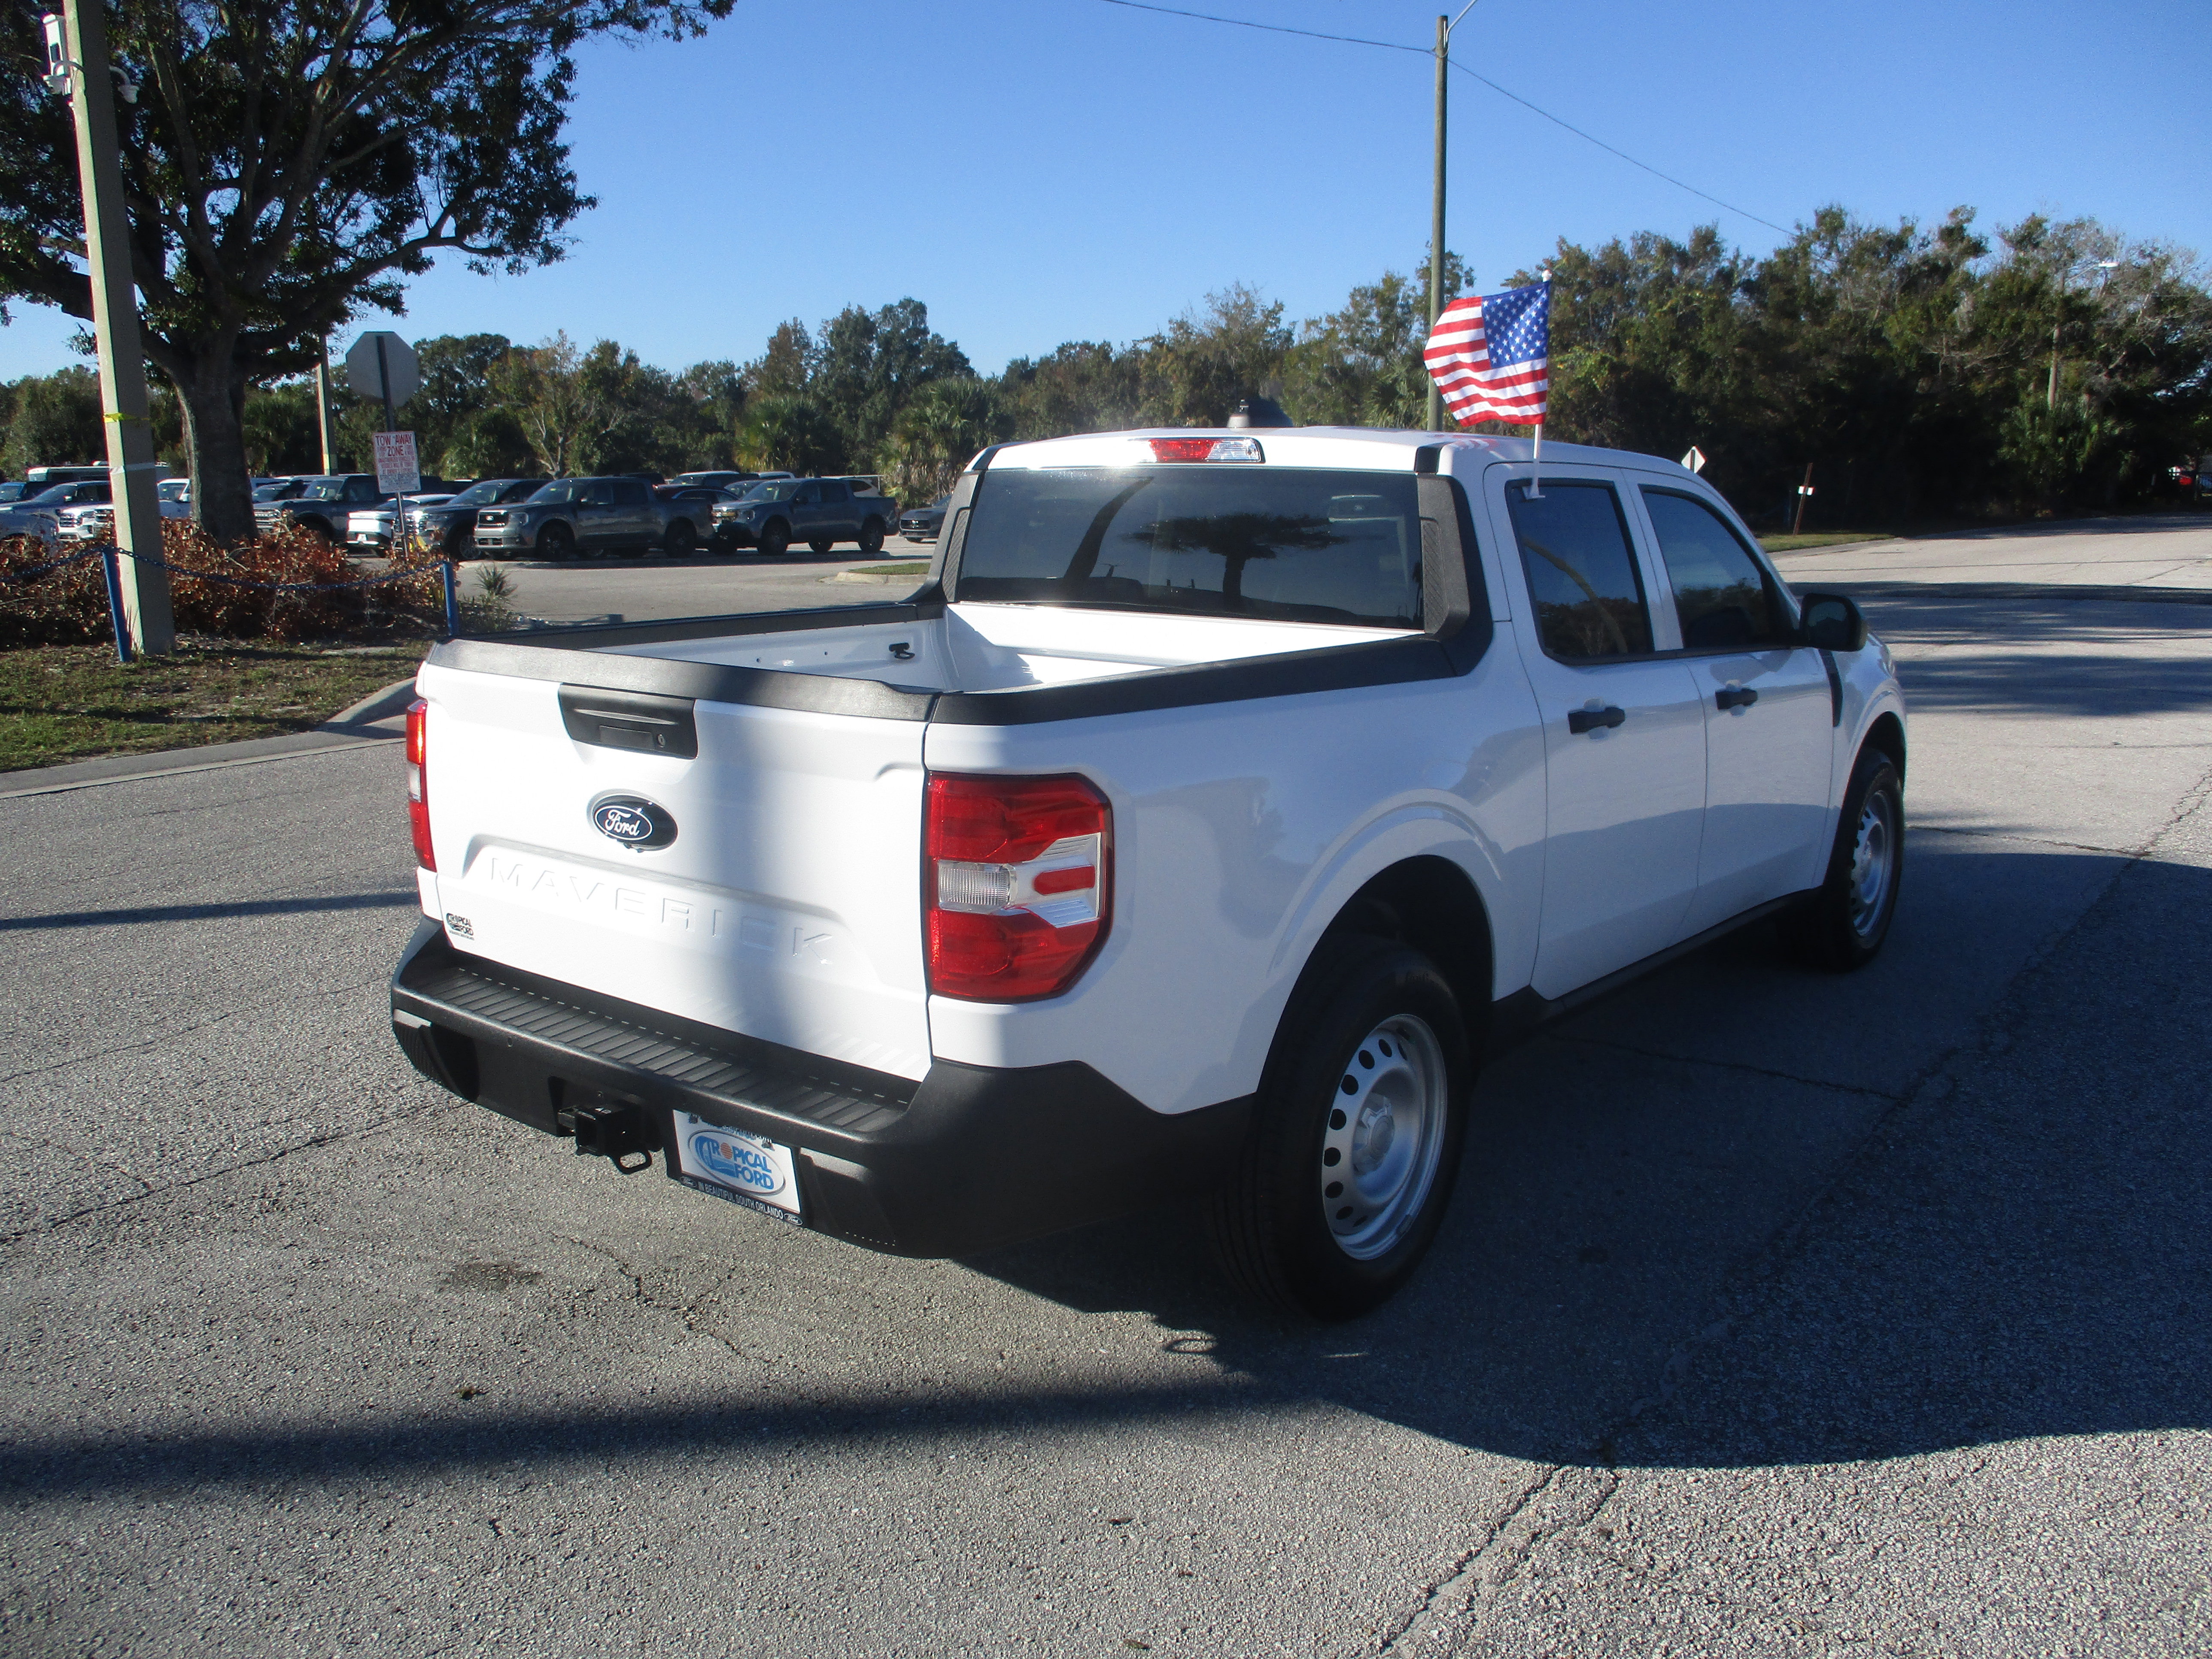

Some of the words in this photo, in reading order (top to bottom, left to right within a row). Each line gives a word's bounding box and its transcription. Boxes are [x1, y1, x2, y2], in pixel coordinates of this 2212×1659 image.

[375, 435, 391, 446] TOW
[395, 434, 412, 445] AWAY
[387, 445, 404, 456] ZONE
[604, 809, 641, 836] Ford
[490, 857, 833, 965] MAVERICK
[735, 1164, 774, 1190] FORD
[698, 1181, 705, 1192] IN
[705, 1183, 736, 1203] BEAUTIFUL
[736, 1194, 755, 1209] SOUTH
[756, 1202, 784, 1220] ORLANDO
